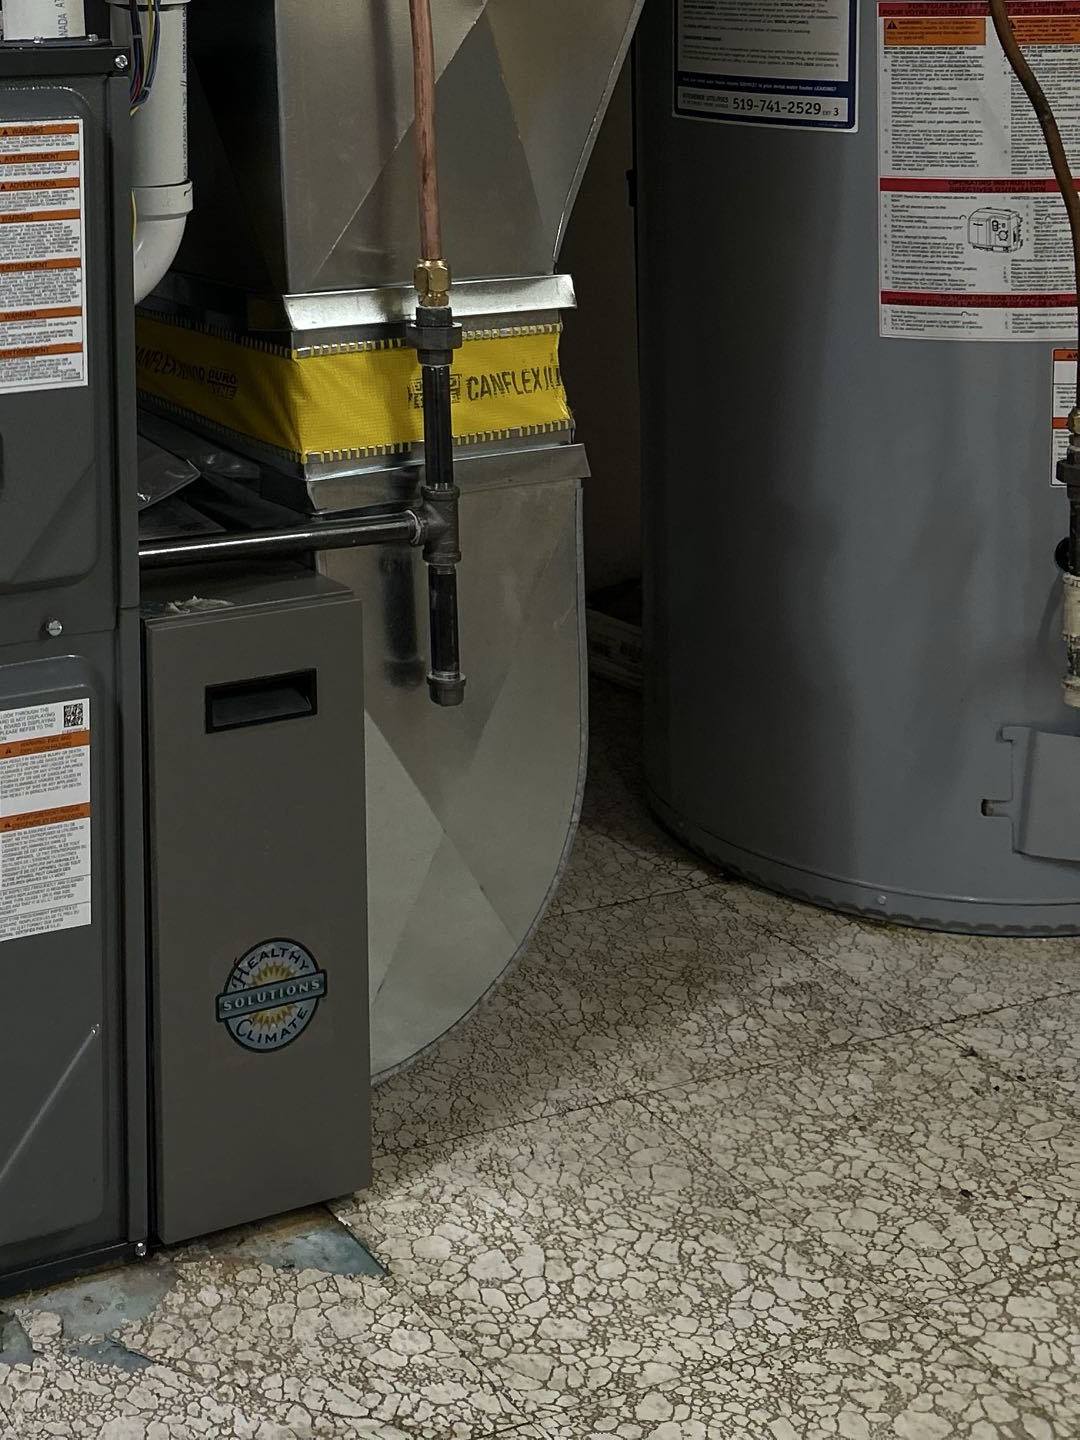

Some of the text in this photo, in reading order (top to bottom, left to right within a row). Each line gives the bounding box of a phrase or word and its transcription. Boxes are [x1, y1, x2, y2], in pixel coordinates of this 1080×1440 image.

[732, 98, 839, 116] 519-741-2529 3
[466, 367, 542, 402] CANFLEX
[231, 948, 309, 989] HEALTHY
[223, 980, 320, 1011] SOLUTIONS
[236, 1006, 308, 1044] CLIMATE
